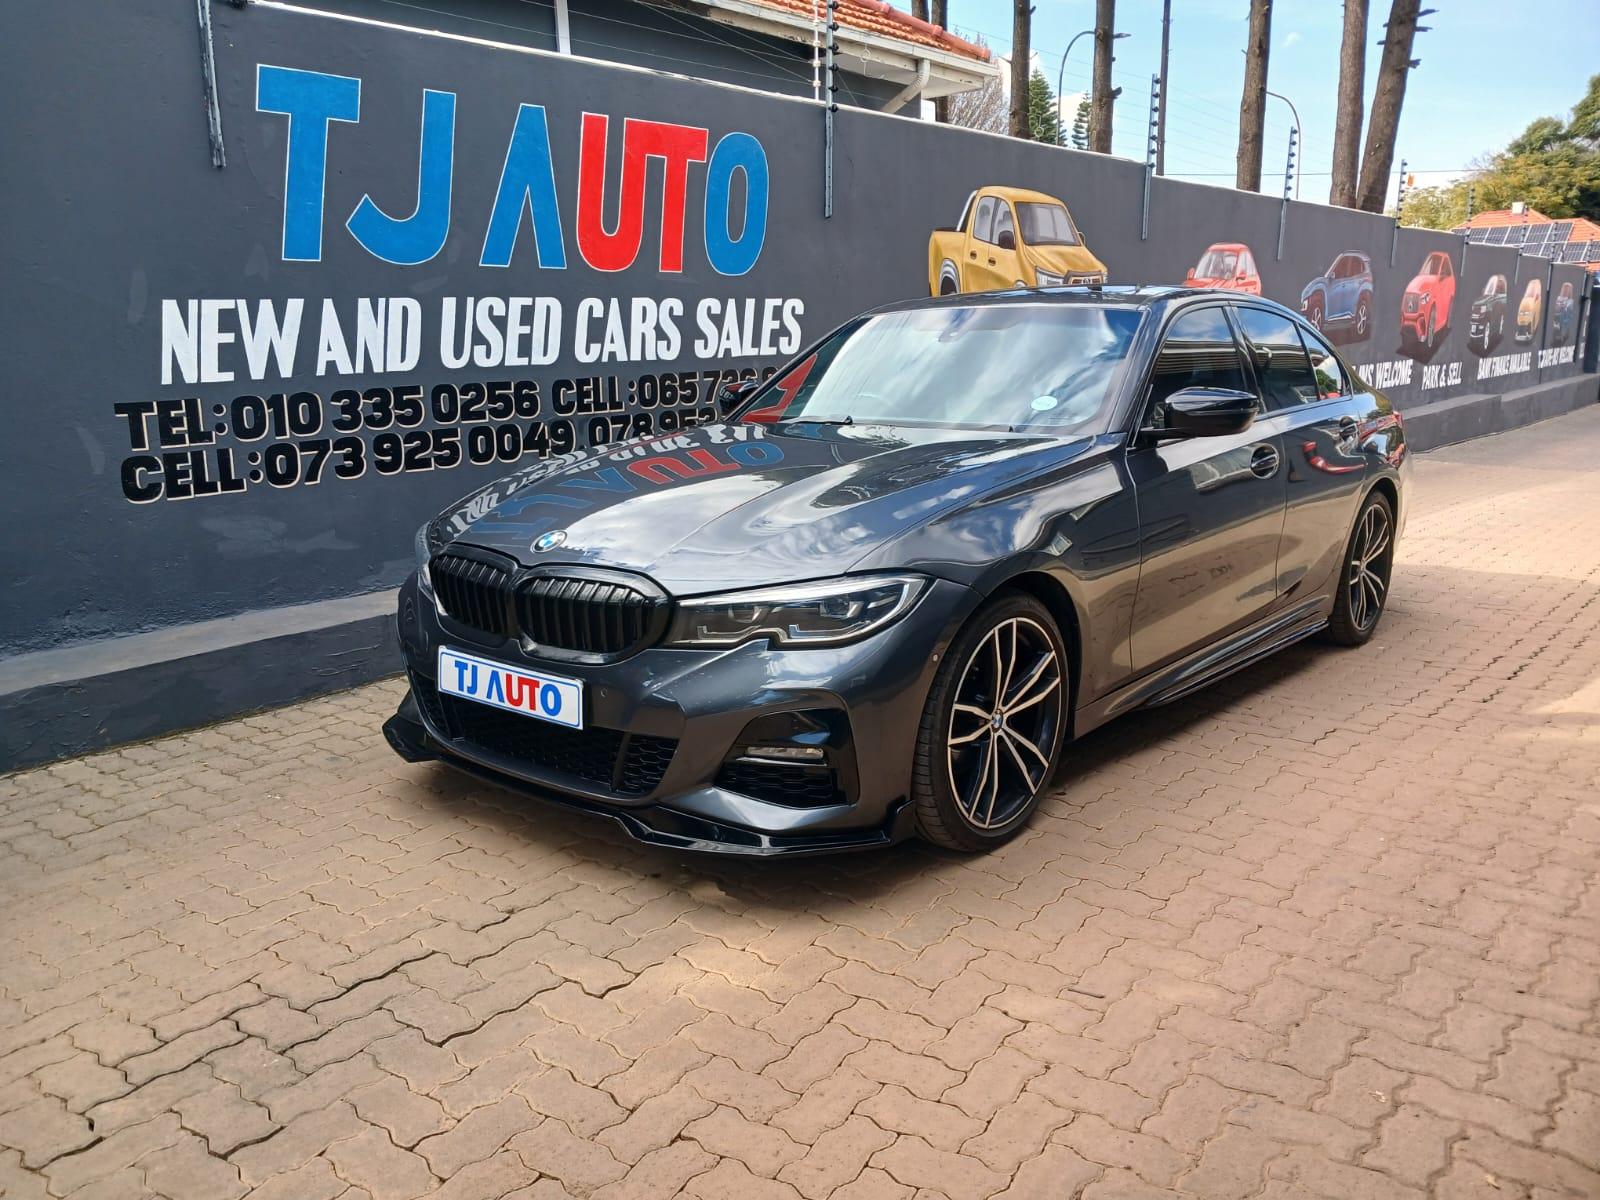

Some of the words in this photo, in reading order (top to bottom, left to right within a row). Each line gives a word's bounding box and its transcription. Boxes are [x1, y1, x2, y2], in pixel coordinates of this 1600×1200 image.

[256, 64, 456, 265] TJ
[479, 103, 769, 276] AUTO
[161, 298, 304, 385] NEW
[316, 297, 422, 376] AND
[441, 296, 562, 368] USED
[574, 297, 683, 362] CARS
[695, 298, 804, 358] SALES
[1376, 359, 1413, 390] WELCOME
[1422, 365, 1440, 390] PARK
[1448, 362, 1462, 386] SELL
[331, 385, 425, 433] 335
[431, 380, 541, 424] 0256
[374, 428, 461, 476] 925
[454, 660, 478, 695] TJ
[486, 670, 562, 716] AUTO
